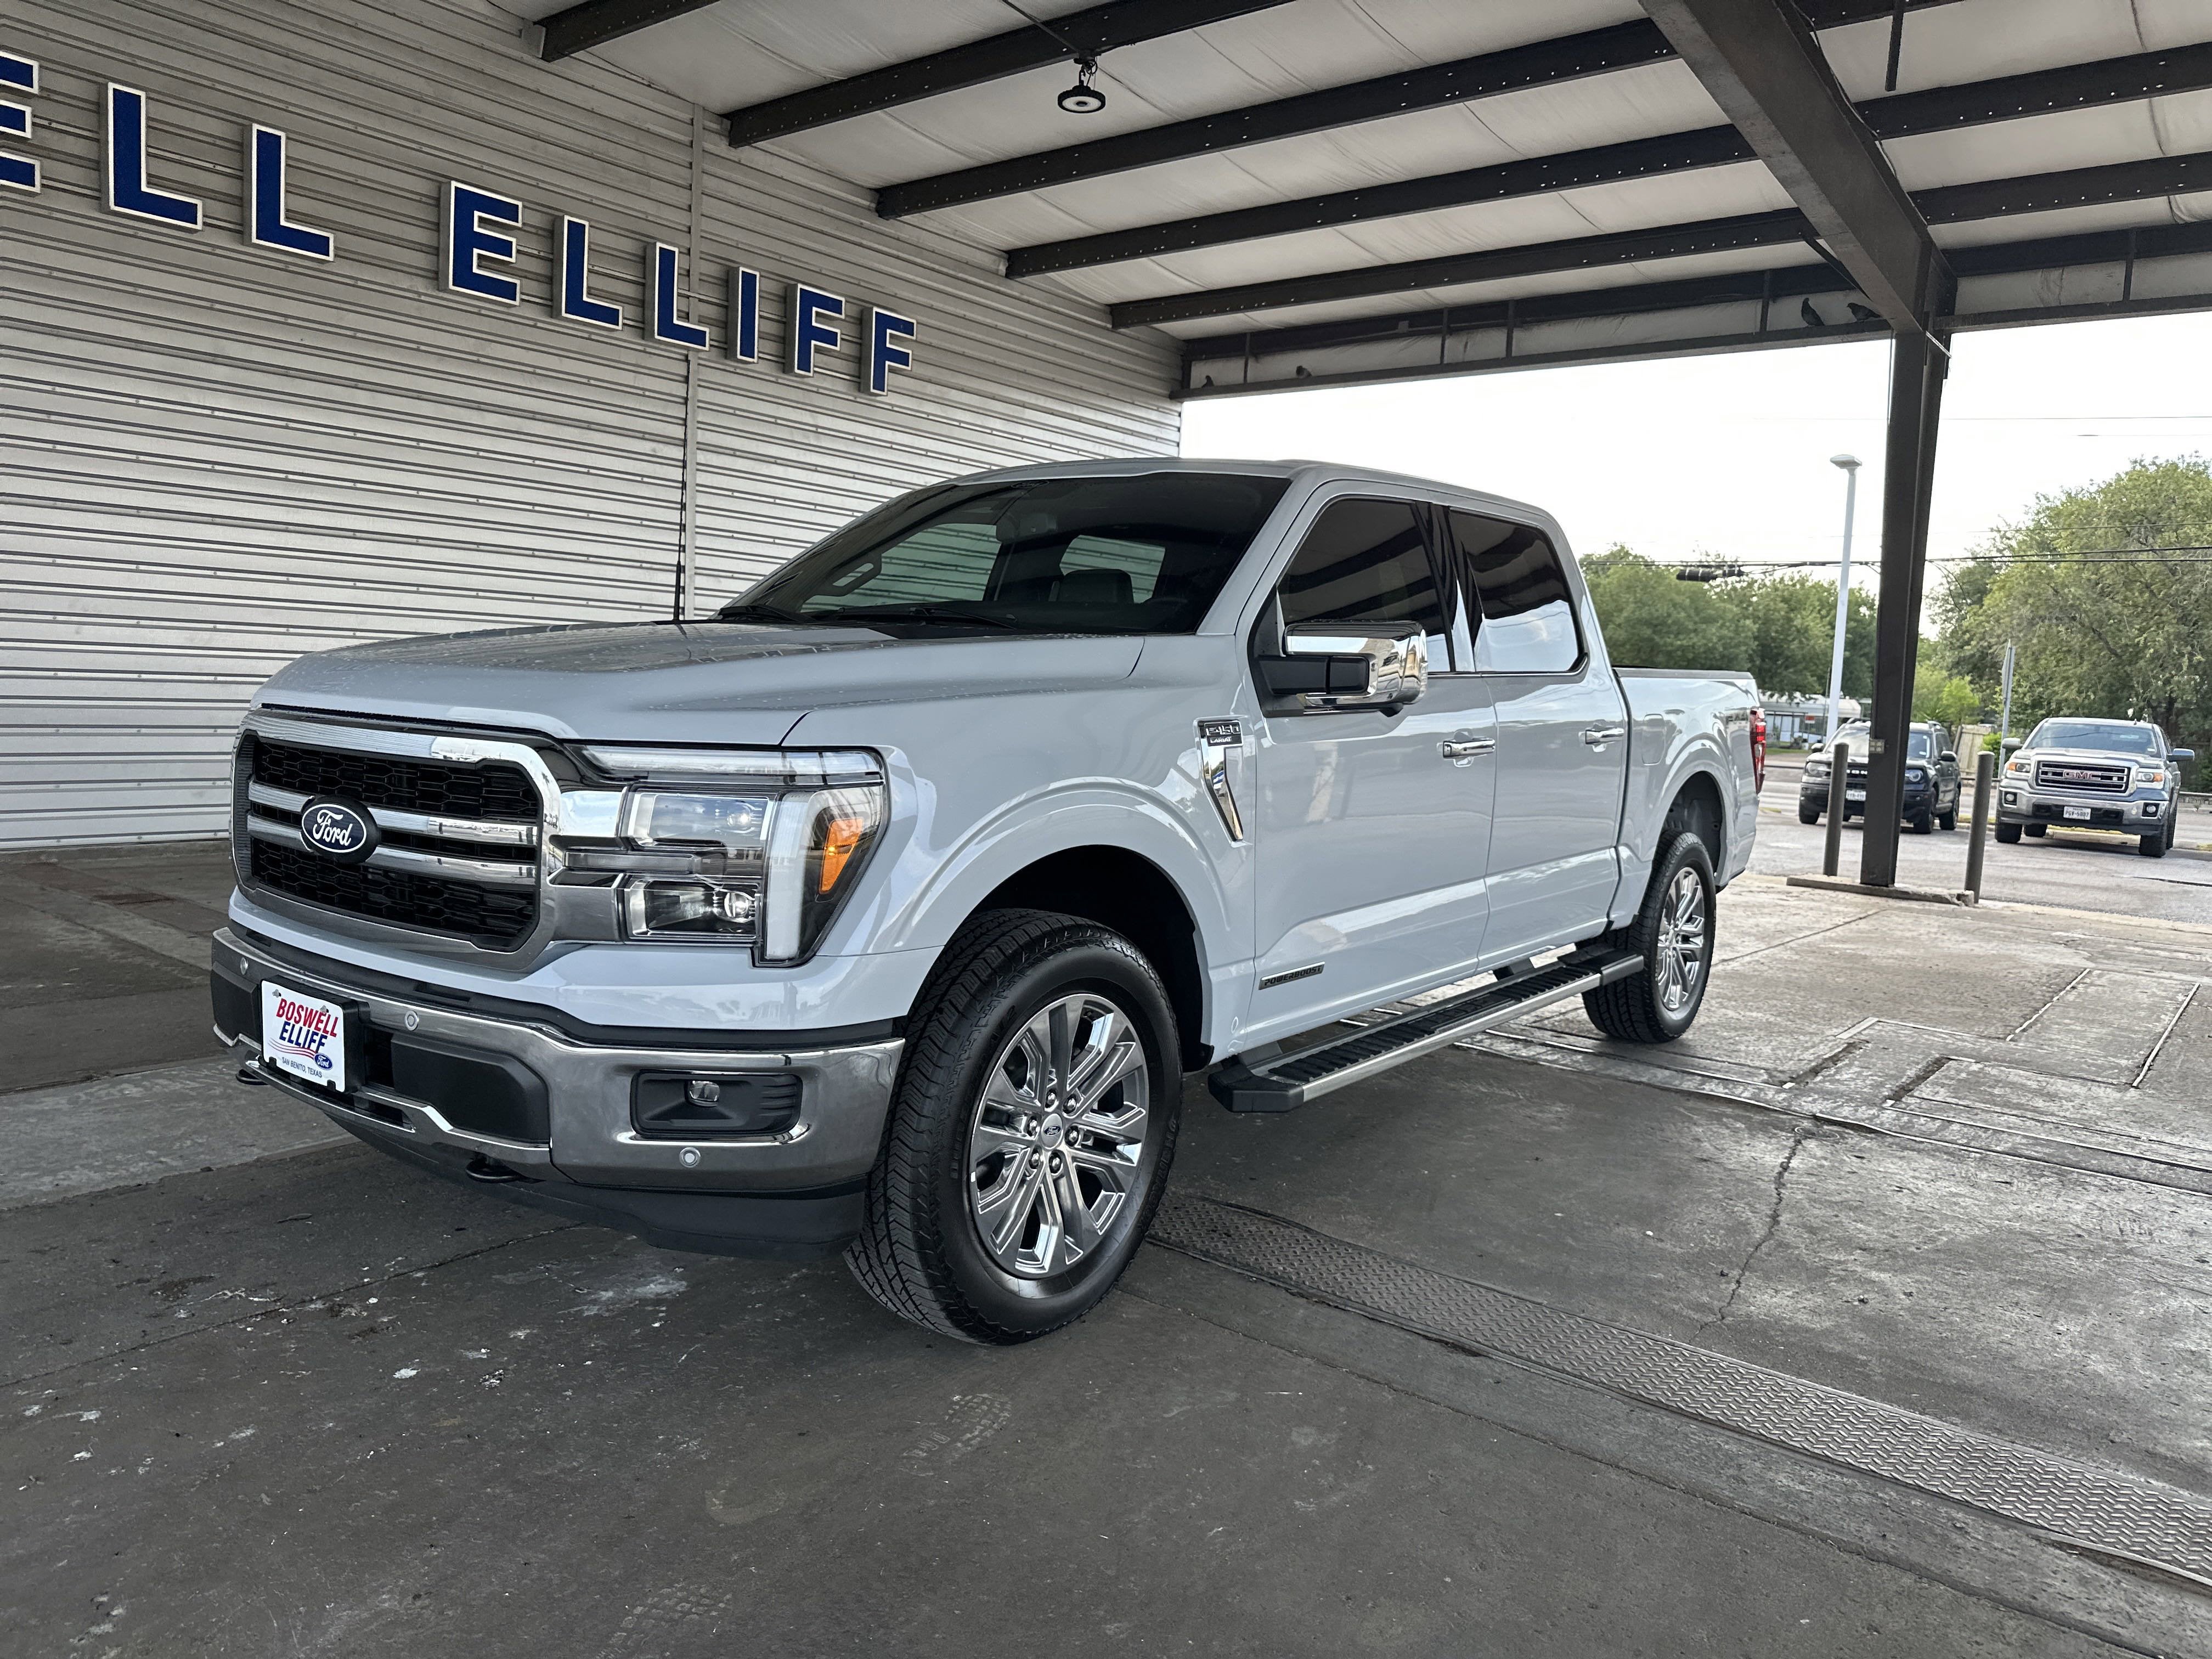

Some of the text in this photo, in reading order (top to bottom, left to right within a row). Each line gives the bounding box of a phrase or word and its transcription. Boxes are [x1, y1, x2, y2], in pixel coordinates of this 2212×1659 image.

[448, 180, 917, 396] ELLIFF
[2063, 769, 2101, 781] GMC
[313, 809, 353, 847] Ford
[1264, 966, 1322, 986] POWERBOOST
[276, 998, 339, 1037] BOSWELL
[279, 1021, 328, 1053] ELLIFF
[281, 1057, 323, 1078] SAN BENITO, TEXAS
[317, 1055, 330, 1068] Ford
